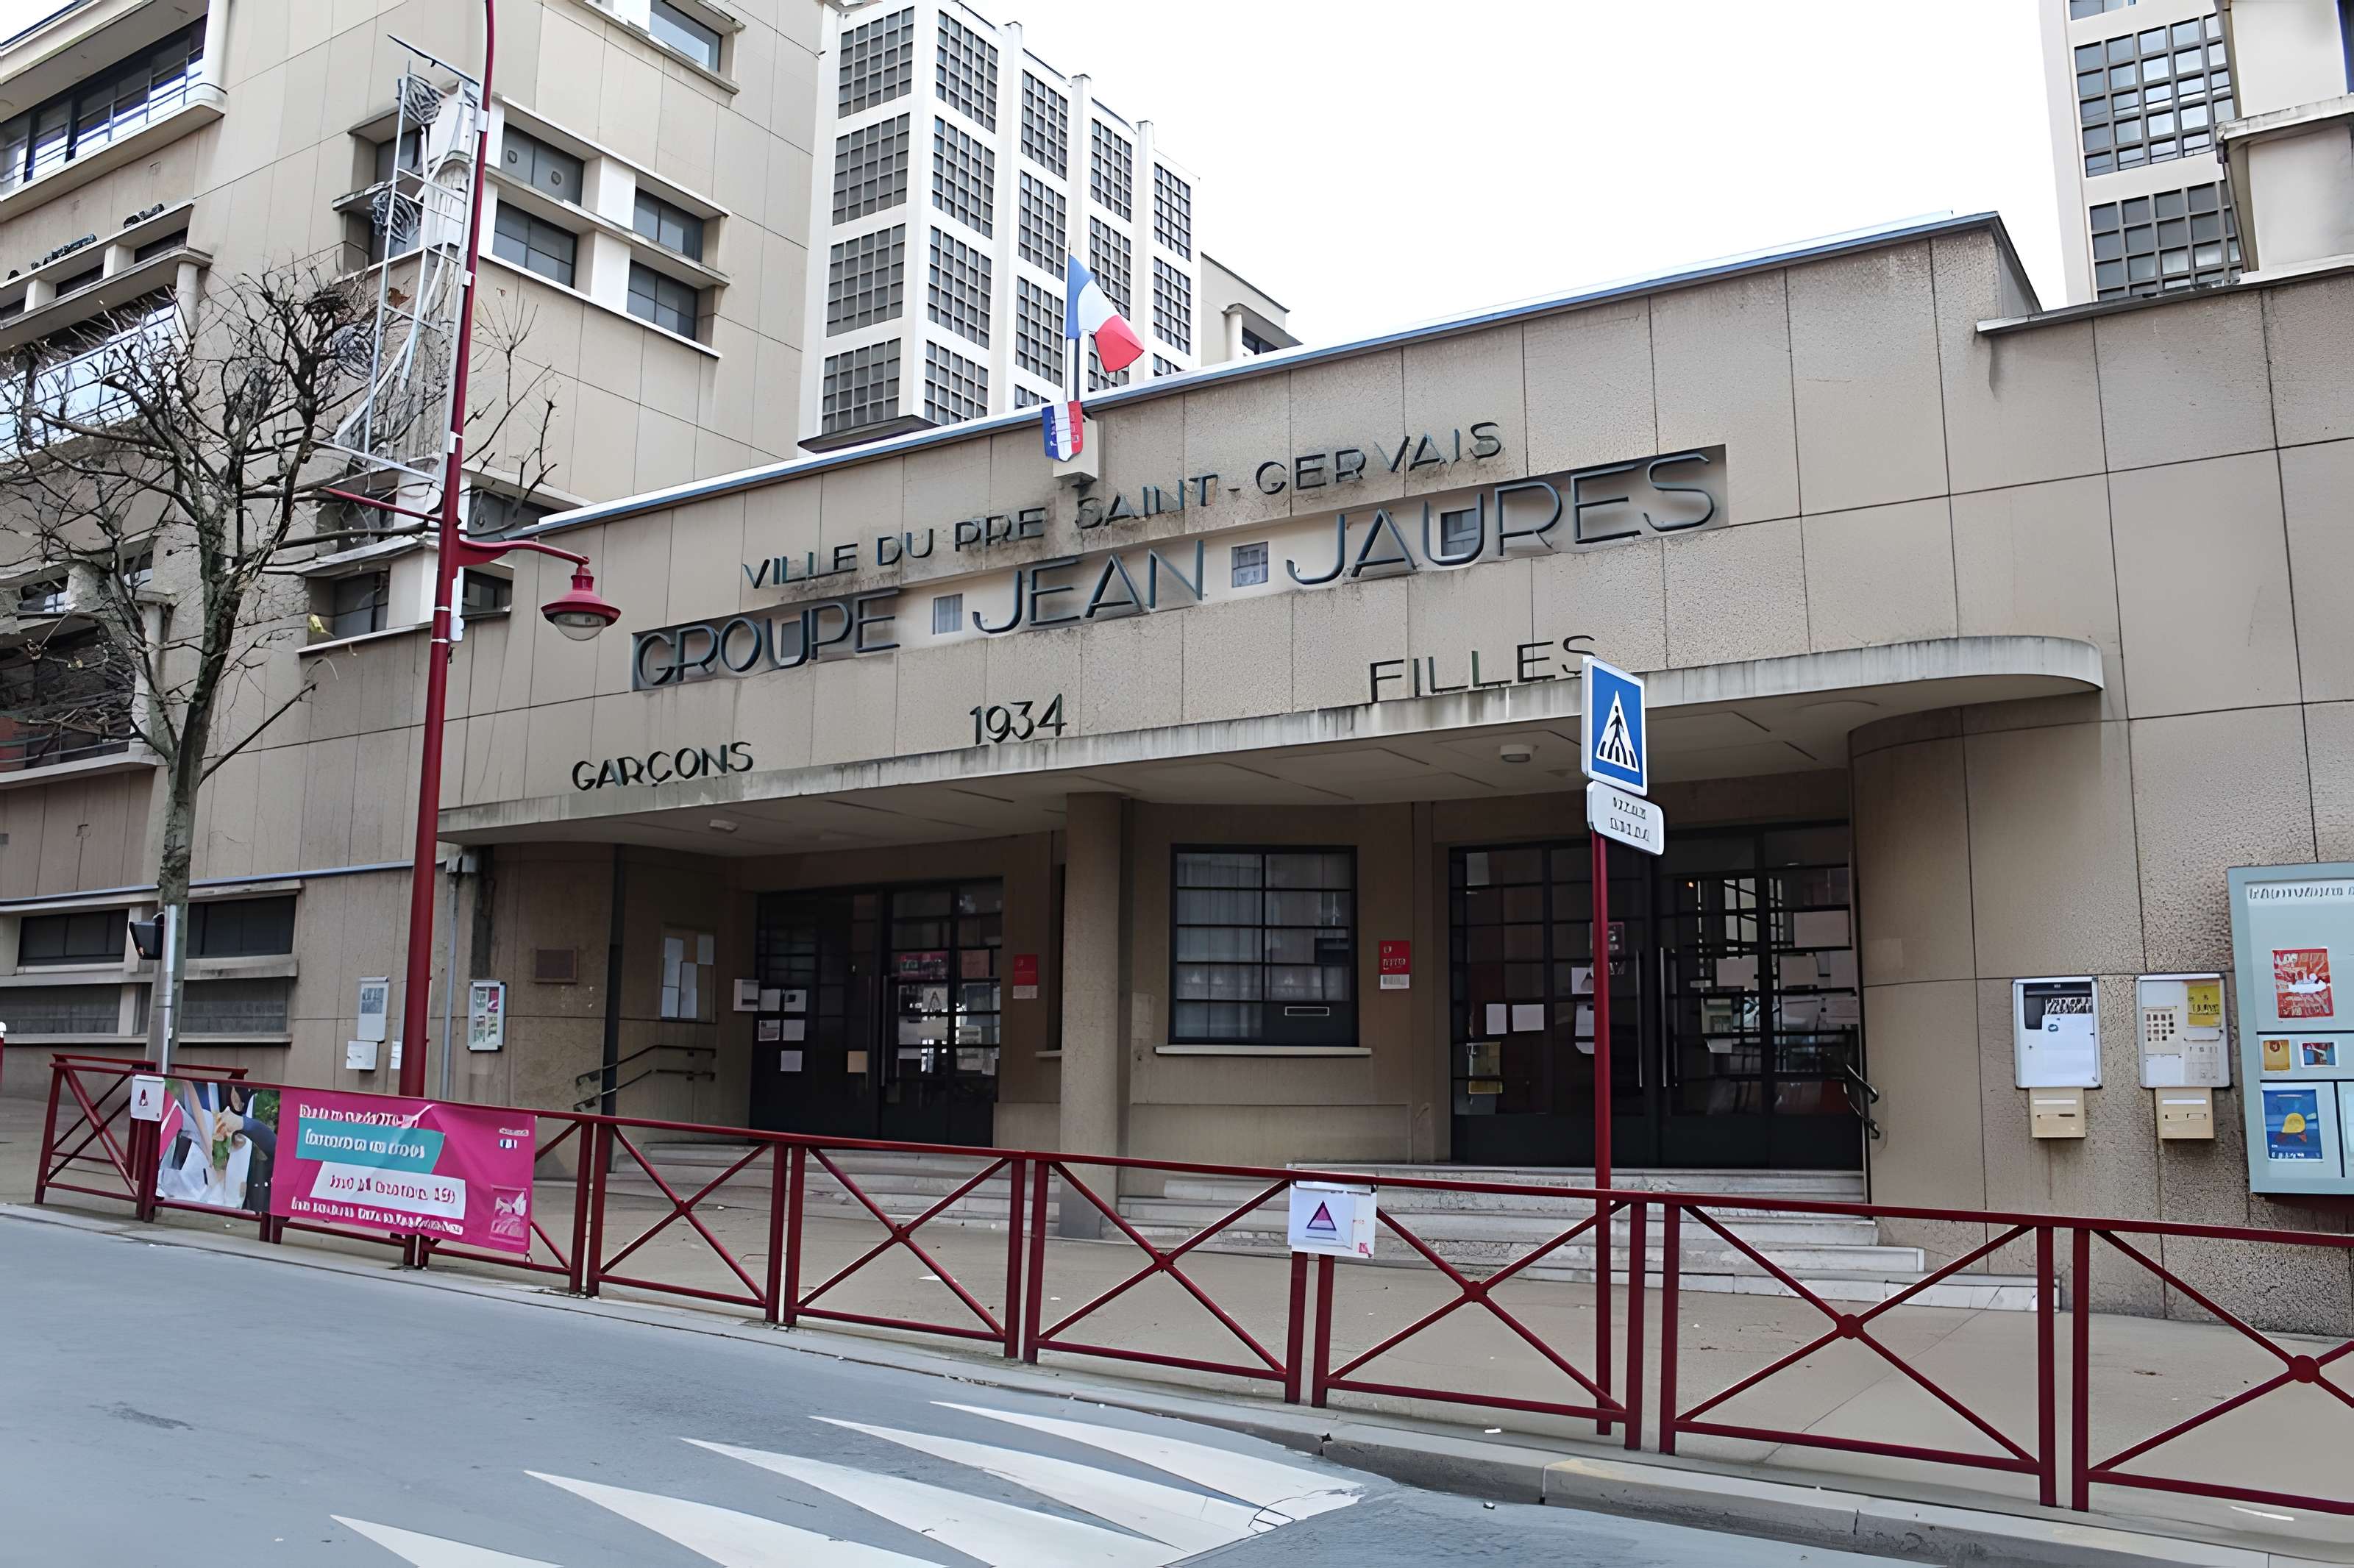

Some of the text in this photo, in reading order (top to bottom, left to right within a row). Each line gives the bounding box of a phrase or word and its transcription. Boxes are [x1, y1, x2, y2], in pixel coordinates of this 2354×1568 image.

[636, 452, 1715, 685] GROUPE JEAN JAURES
[742, 544, 858, 589] VILLE
[877, 528, 934, 566] DU
[955, 507, 1047, 552] PRE
[1370, 635, 1596, 702] FILLES
[970, 693, 1067, 745] 1934
[572, 741, 754, 791] GARÇONS
